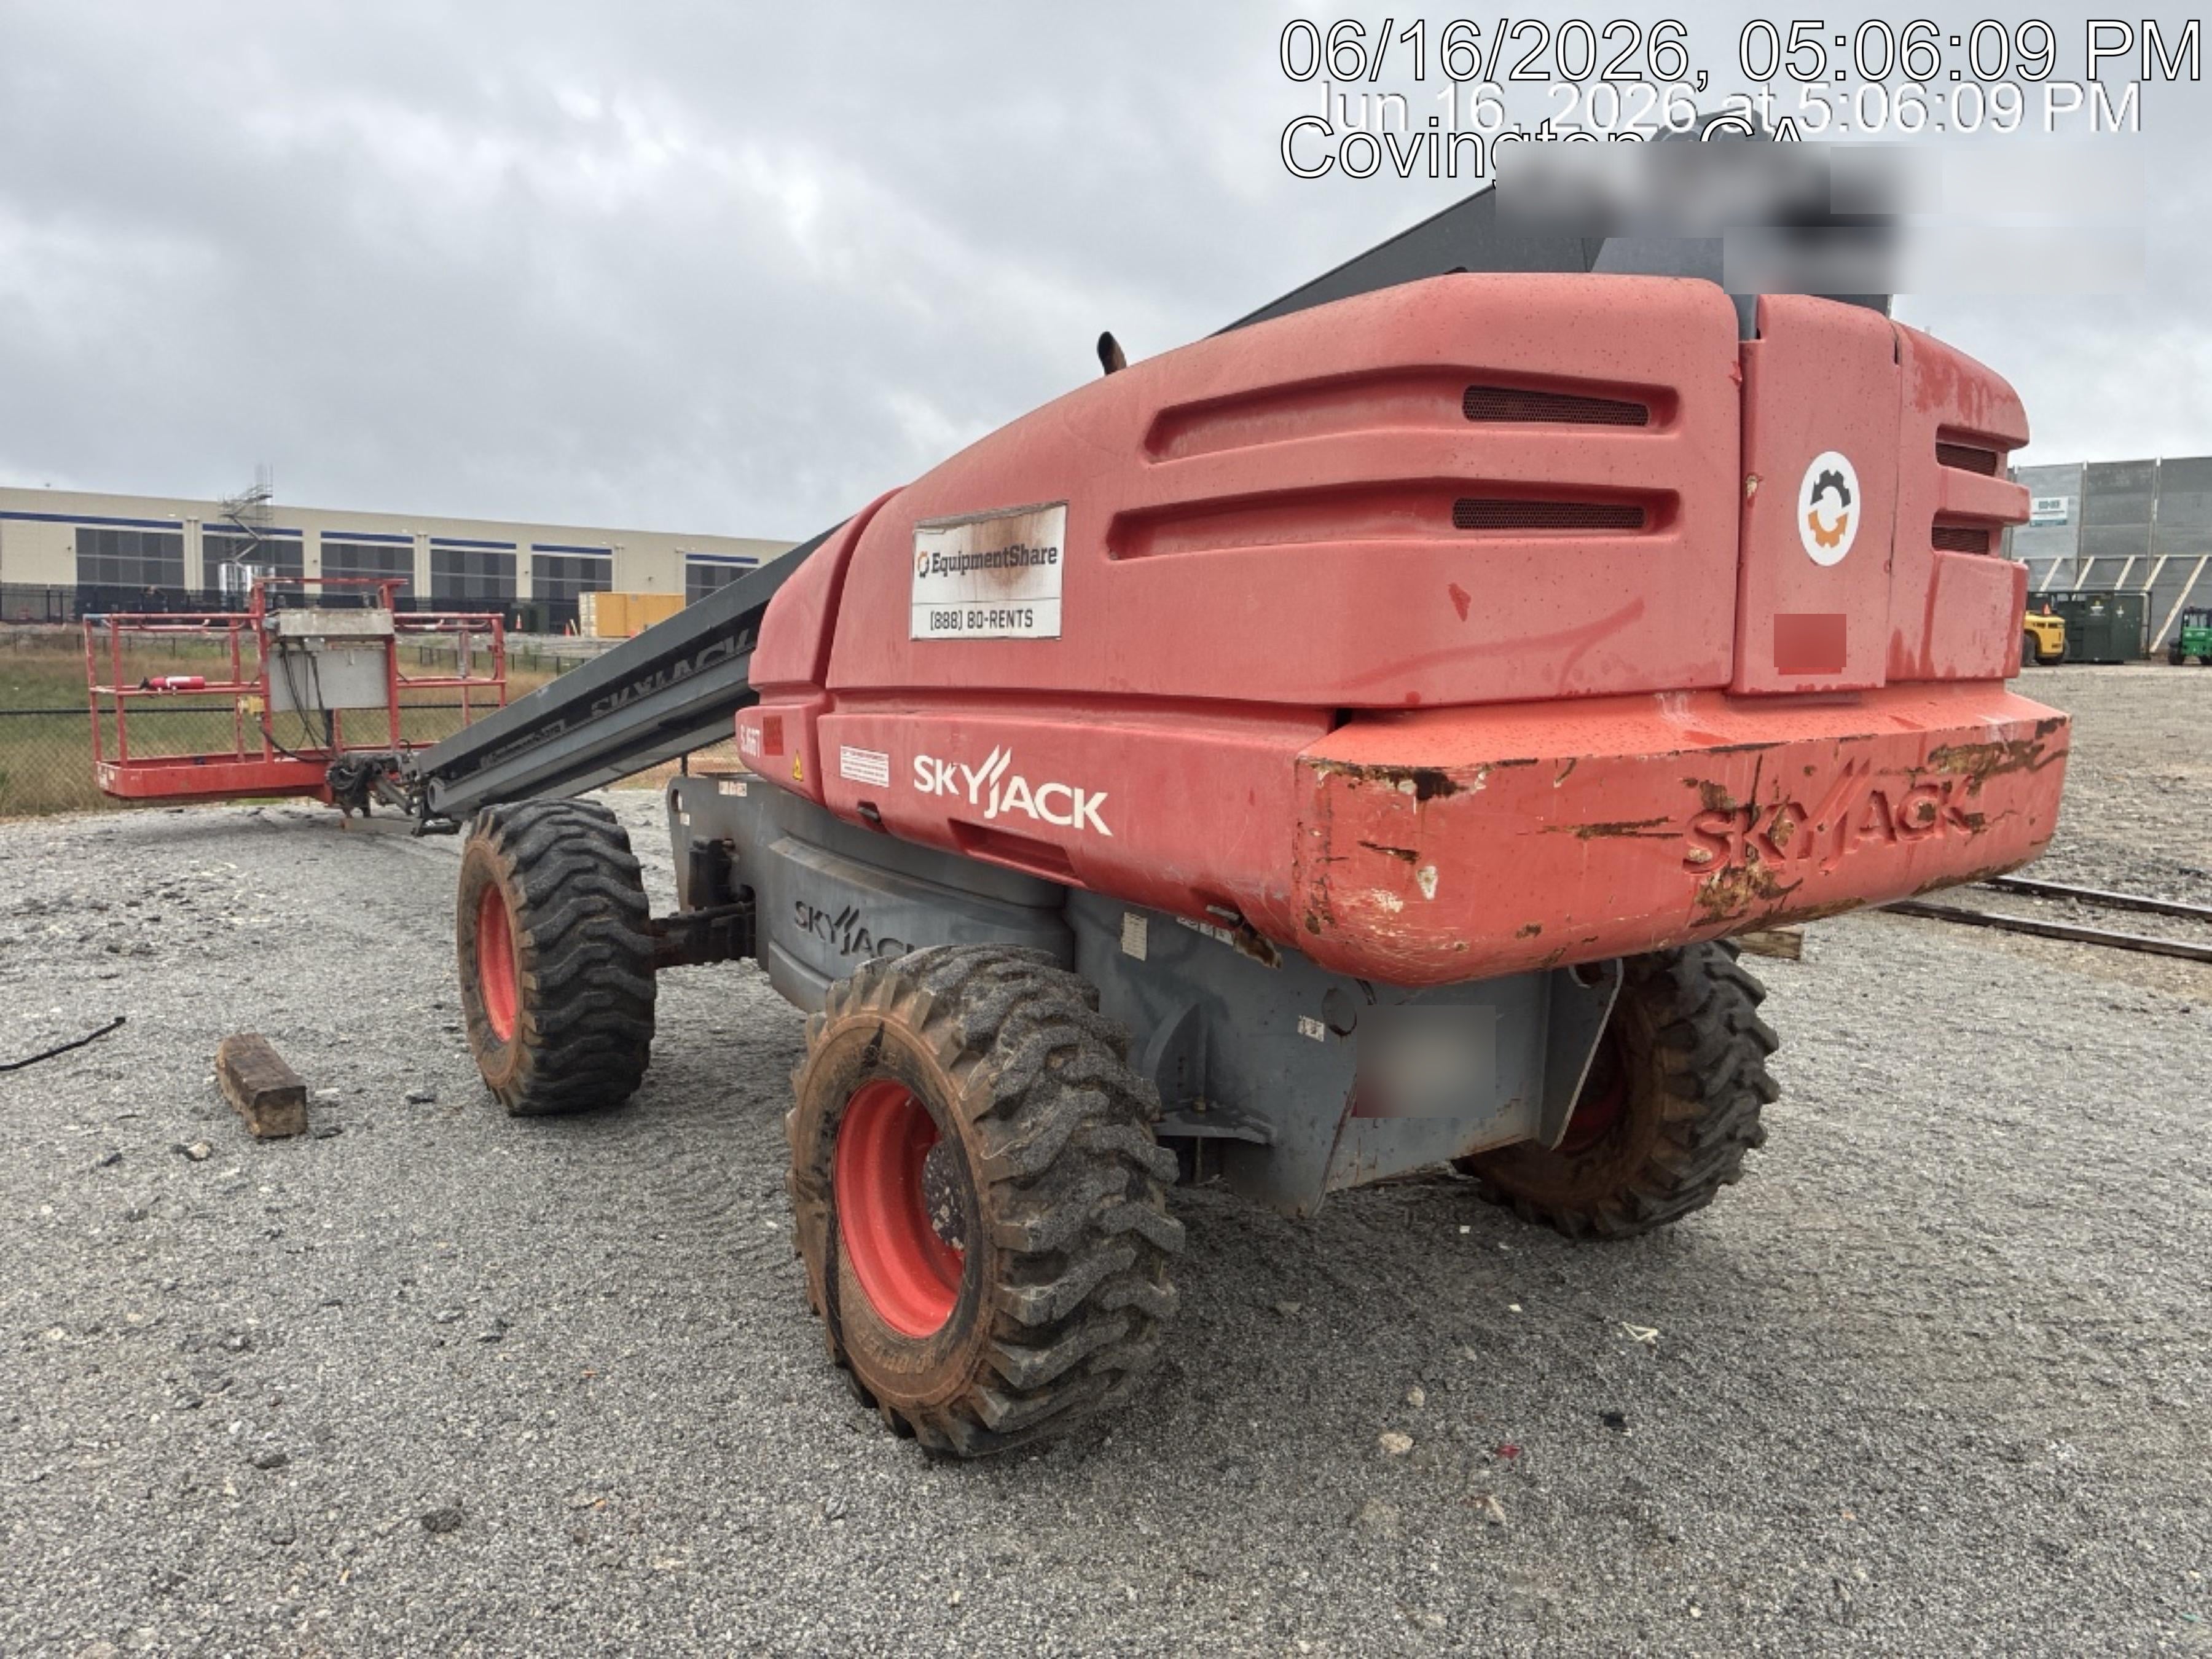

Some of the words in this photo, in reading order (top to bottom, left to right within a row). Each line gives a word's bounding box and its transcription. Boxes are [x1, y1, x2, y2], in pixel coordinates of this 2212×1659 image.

[931, 544, 1057, 576] EquipmentShare
[930, 610, 962, 631] (888)
[967, 609, 1033, 630] 80-RENTS
[913, 744, 1113, 836] SKYJACK
[1682, 756, 1972, 876] SKYJACK
[794, 901, 915, 957] SKYJAC
